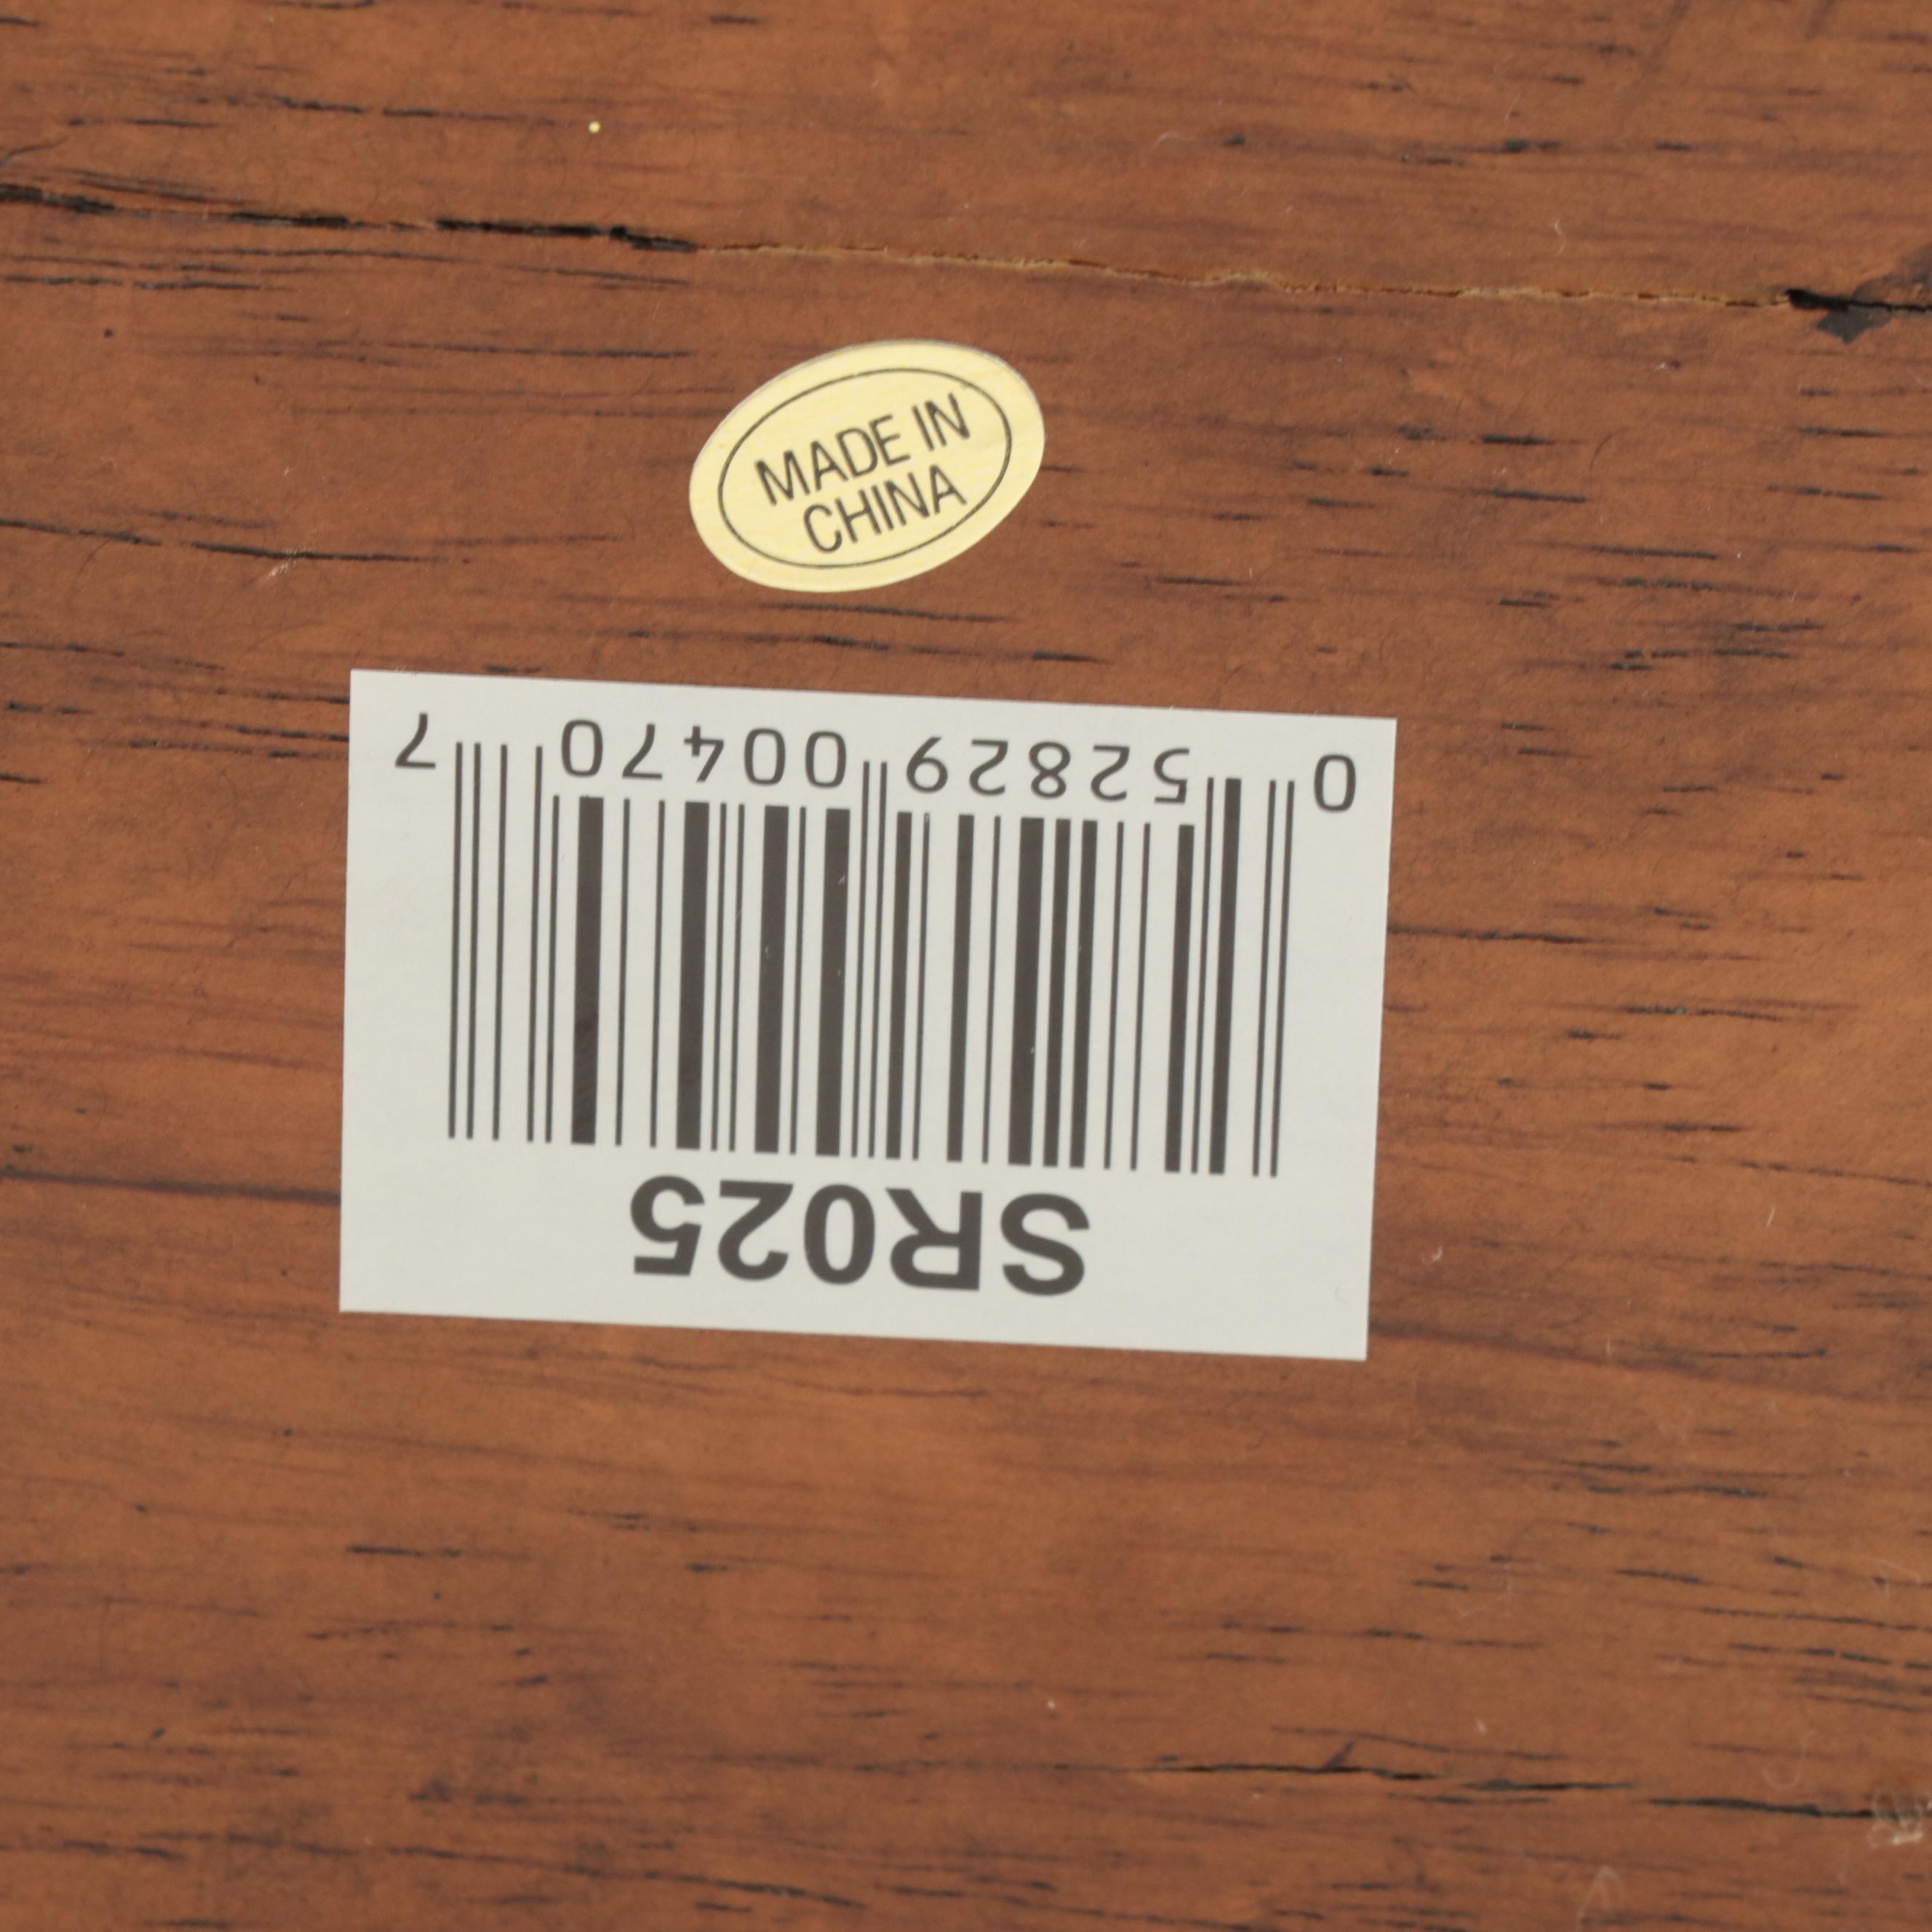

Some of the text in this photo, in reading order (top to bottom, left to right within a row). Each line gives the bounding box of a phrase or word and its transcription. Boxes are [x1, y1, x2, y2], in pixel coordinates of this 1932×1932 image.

[754, 393, 971, 506] MADE IN
[803, 464, 968, 554] CHINA
[394, 712, 1357, 813] 0 52829 00470 7
[629, 1175, 1090, 1297] SR025
